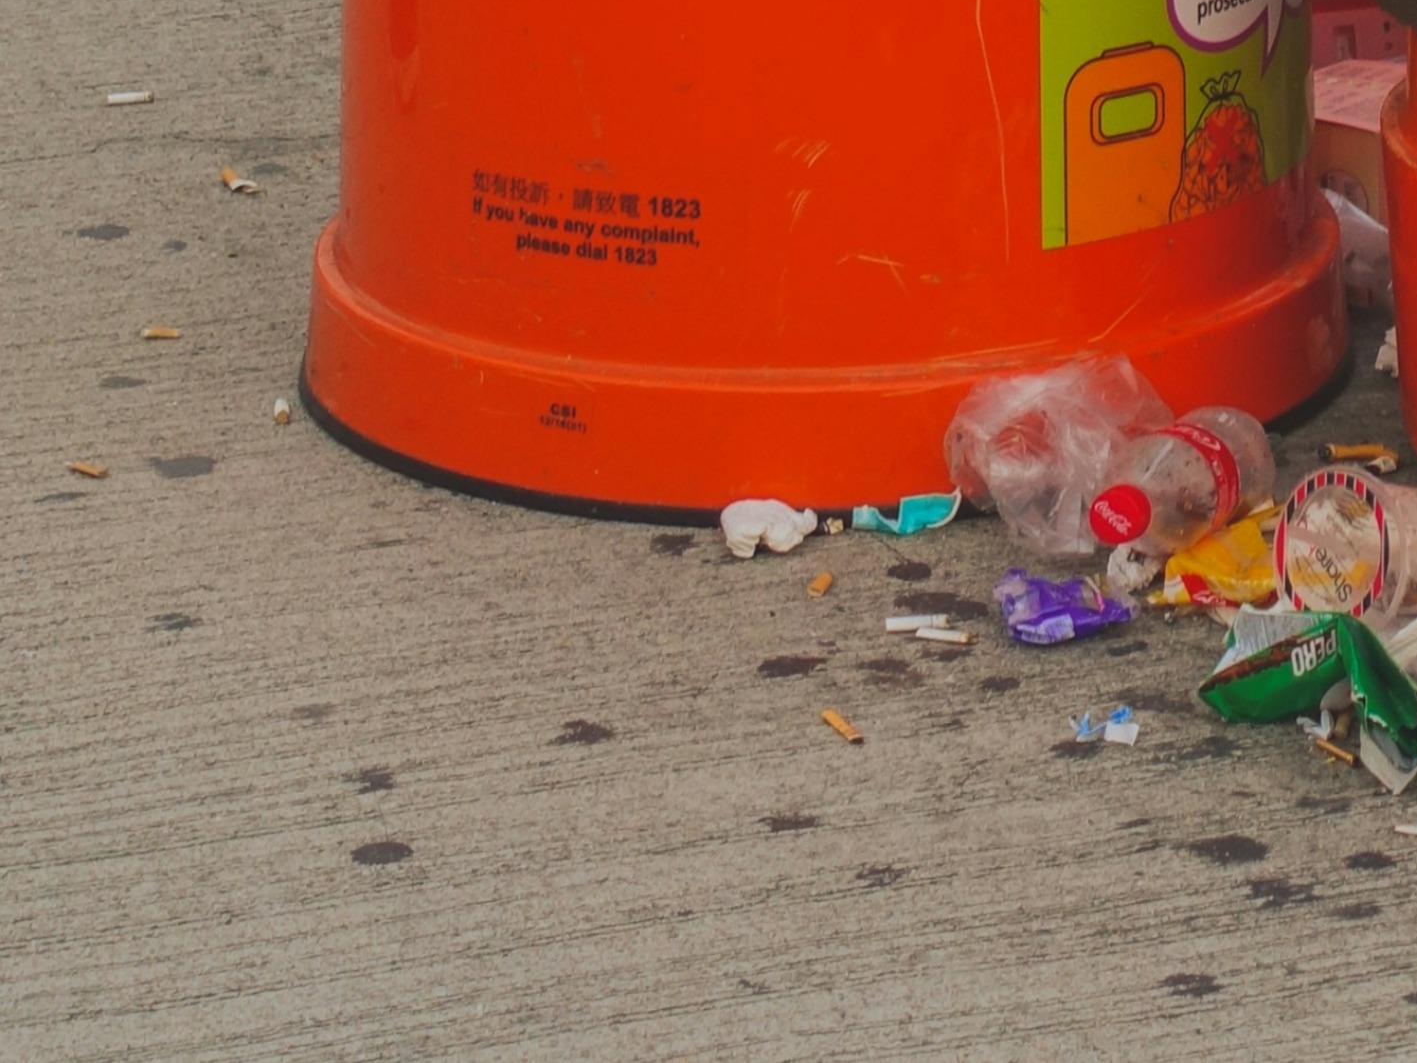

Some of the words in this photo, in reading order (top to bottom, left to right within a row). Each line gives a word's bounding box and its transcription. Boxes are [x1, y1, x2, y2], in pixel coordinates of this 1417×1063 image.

[472, 197, 482, 214] If
[486, 205, 514, 222] you
[519, 207, 558, 229] have
[564, 218, 595, 238] any
[600, 221, 700, 247] complaint,
[648, 196, 701, 219] 1823
[516, 232, 570, 256] please
[576, 243, 608, 261] dial
[615, 248, 657, 266] 1823
